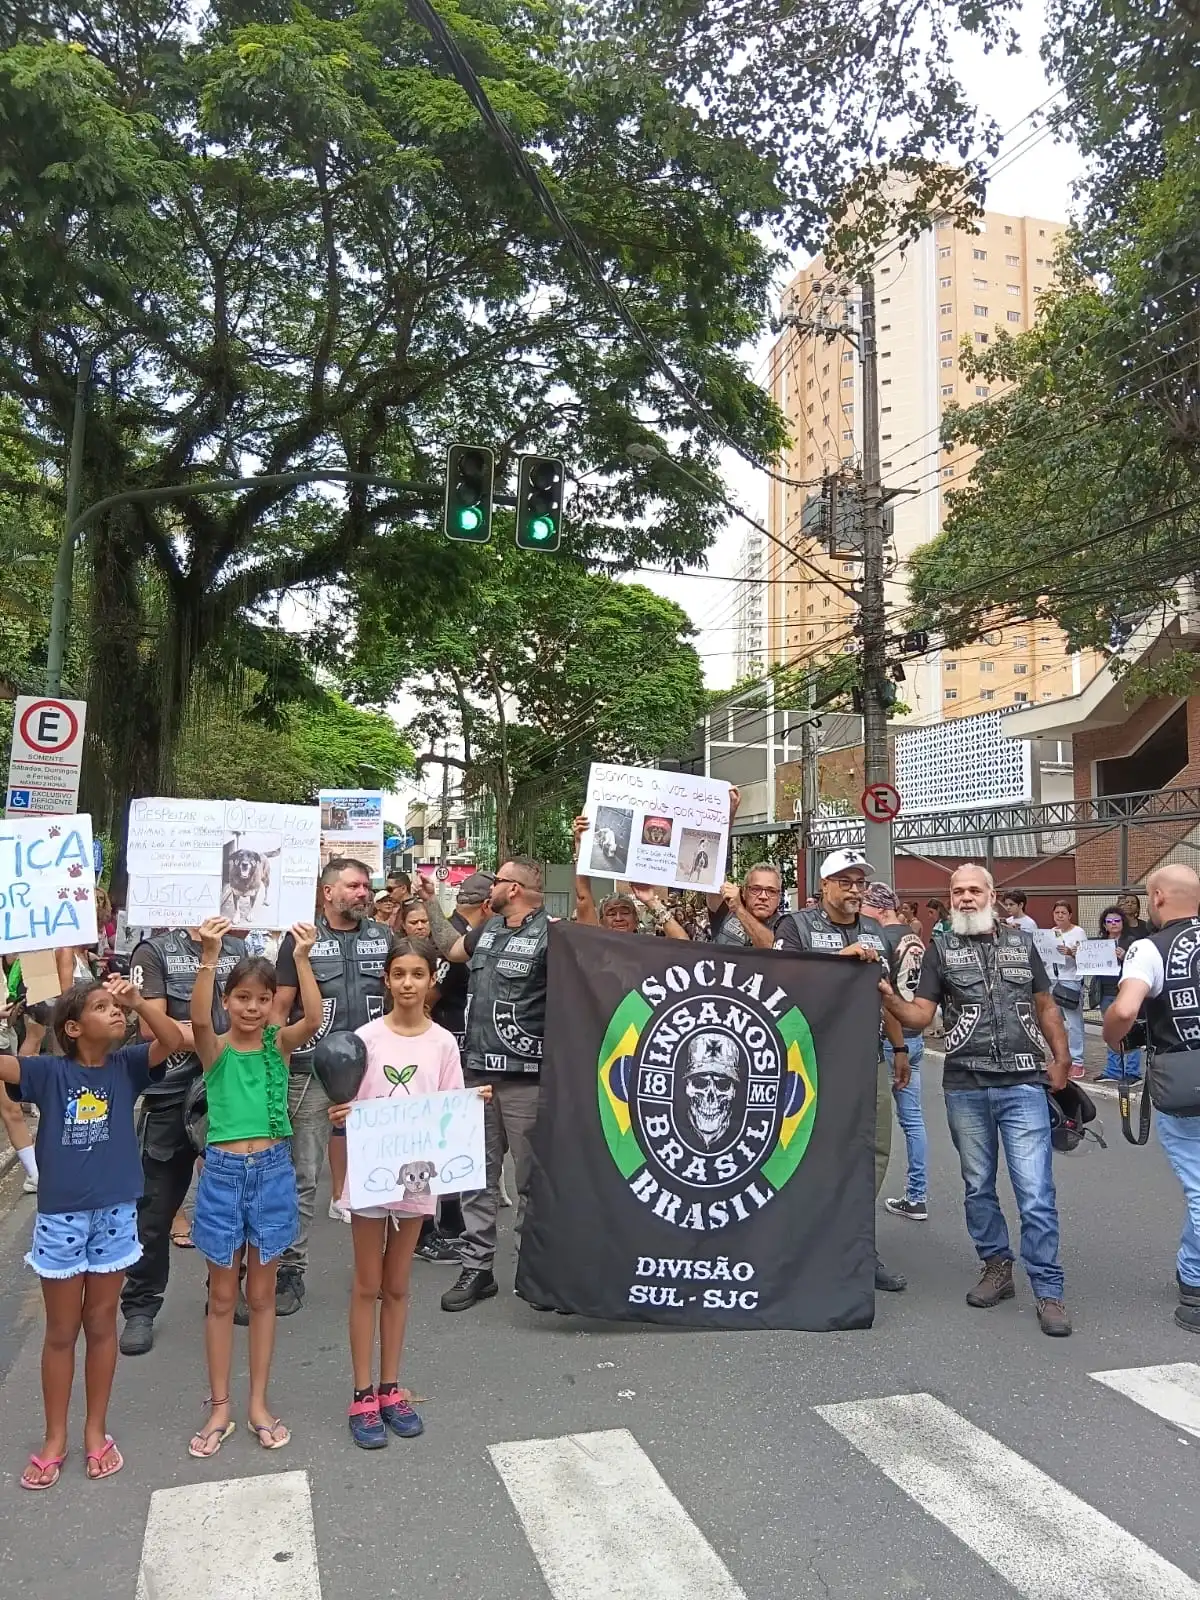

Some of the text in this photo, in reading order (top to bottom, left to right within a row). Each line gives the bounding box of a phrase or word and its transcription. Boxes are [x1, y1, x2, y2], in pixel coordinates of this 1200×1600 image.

[38, 711, 60, 742] E
[27, 753, 64, 763] SOMENTE
[44, 766, 78, 775] Domingos
[31, 790, 72, 799] EXCLUSIVO
[31, 797, 73, 806] DEFICIENTE
[874, 791, 888, 813] E
[0, 830, 89, 877] IÇA
[0, 900, 80, 940] LHA
[641, 960, 788, 1018] SOCIAL
[1175, 991, 1193, 1008] 18
[649, 1002, 776, 1073] INSANOS
[944, 1006, 978, 1050] OCIAL
[489, 1056, 502, 1066] VI
[1019, 1056, 1032, 1068] VI
[643, 1072, 667, 1095] 18
[749, 1084, 776, 1103] MC
[350, 1098, 432, 1131] JUSTIÇA
[645, 1113, 769, 1183] BRASIL
[628, 1168, 775, 1231] BRASIL
[635, 1255, 756, 1282] DIVISÃO
[628, 1284, 684, 1308] SUL
[702, 1288, 759, 1310] SJC
